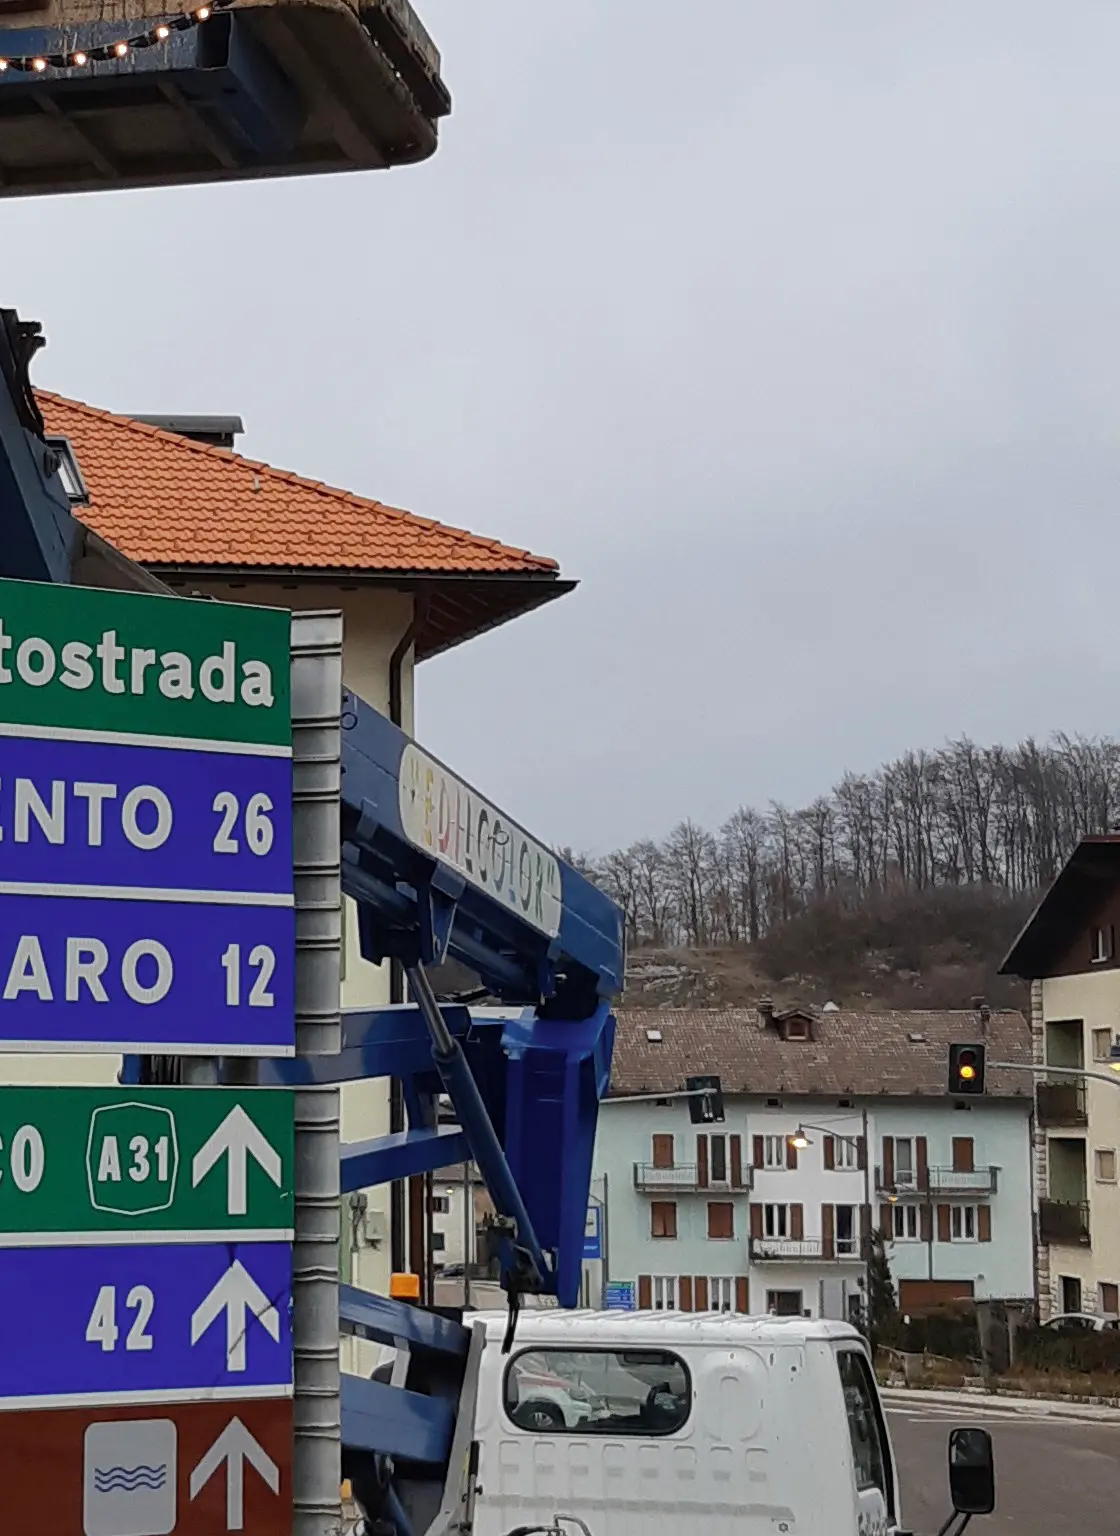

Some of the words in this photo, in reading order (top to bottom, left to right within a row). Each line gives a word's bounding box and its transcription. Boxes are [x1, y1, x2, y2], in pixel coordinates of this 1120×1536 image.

[212, 791, 274, 856] 26
[221, 943, 276, 1007] 12
[97, 1135, 169, 1182] A31
[85, 1285, 155, 1351] 42
